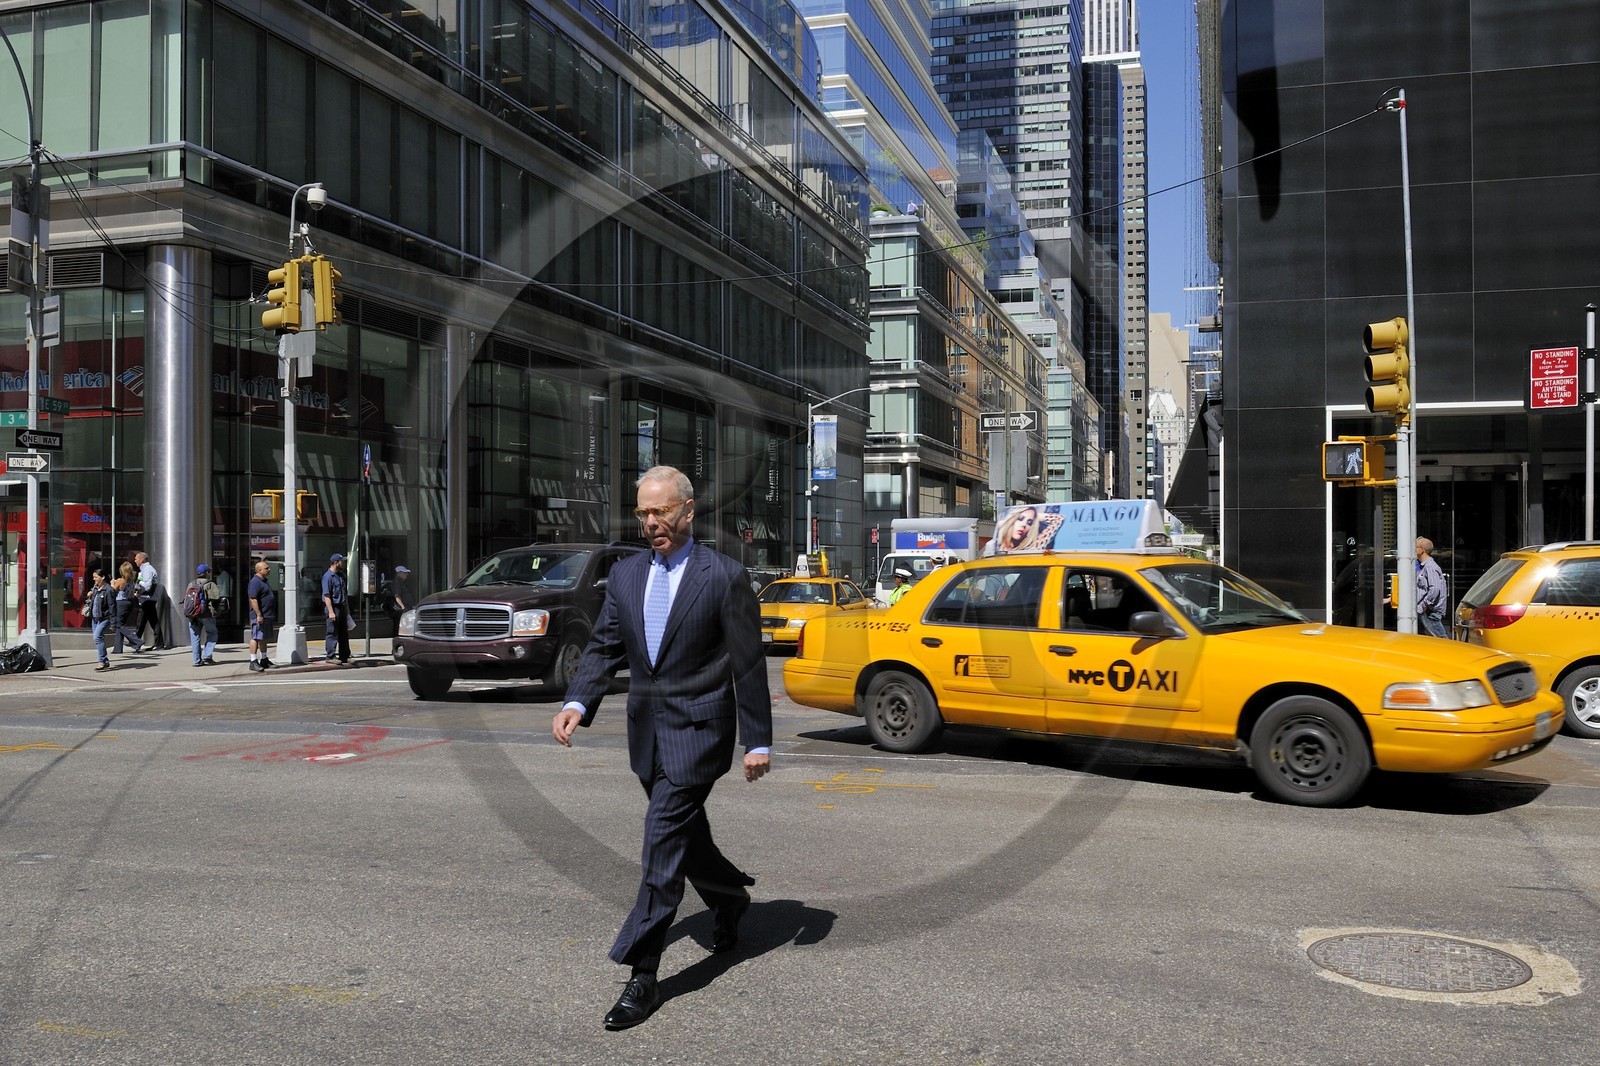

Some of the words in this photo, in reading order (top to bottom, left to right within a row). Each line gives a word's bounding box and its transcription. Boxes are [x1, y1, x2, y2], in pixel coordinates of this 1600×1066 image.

[1553, 391, 1572, 399] STAND
[45, 399, 50, 410] E
[52, 400, 62, 412] 59
[8, 413, 15, 425] 3
[988, 418, 1005, 426] ONE
[1011, 417, 1028, 425] WAY
[22, 434, 38, 443] ONE
[42, 436, 58, 446] WAY
[12, 458, 25, 467] ONE
[30, 458, 43, 468] WAY
[1070, 505, 1140, 523] MANGO
[917, 532, 946, 543] Budget
[888, 622, 911, 633] 1E54
[1068, 668, 1105, 686] NYC
